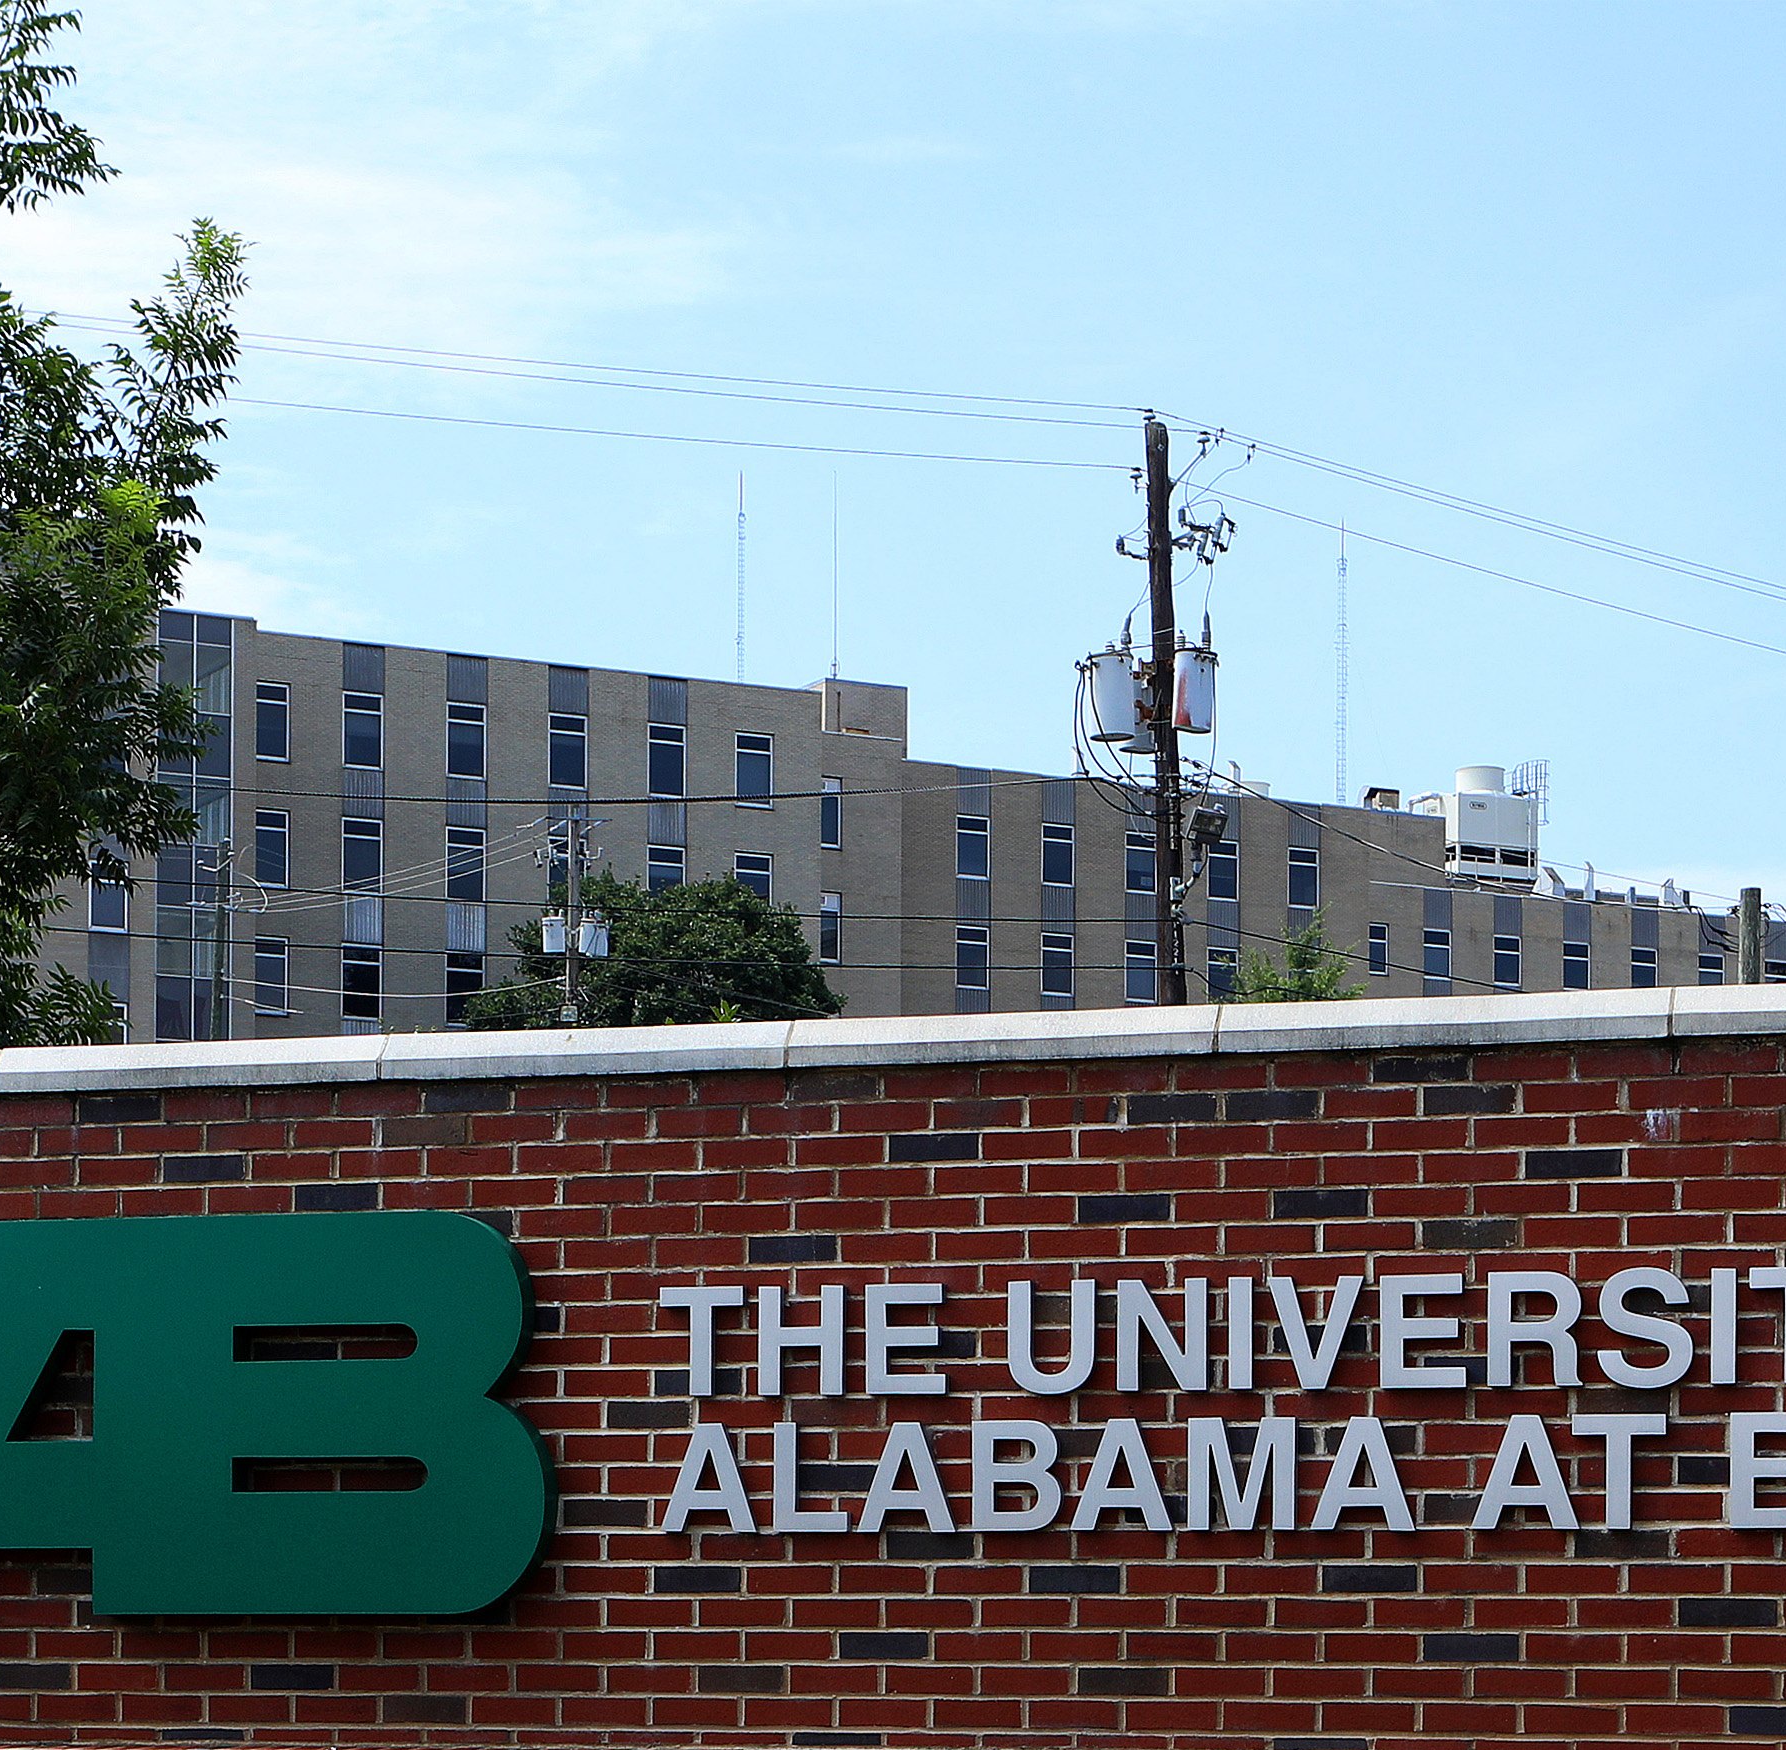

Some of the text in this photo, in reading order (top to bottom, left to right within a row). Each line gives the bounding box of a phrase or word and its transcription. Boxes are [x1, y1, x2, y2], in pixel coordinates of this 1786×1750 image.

[659, 1283, 947, 1396] THE
[661, 1416, 1415, 1534] ALABAMA
[1472, 1413, 1668, 1531] AT
